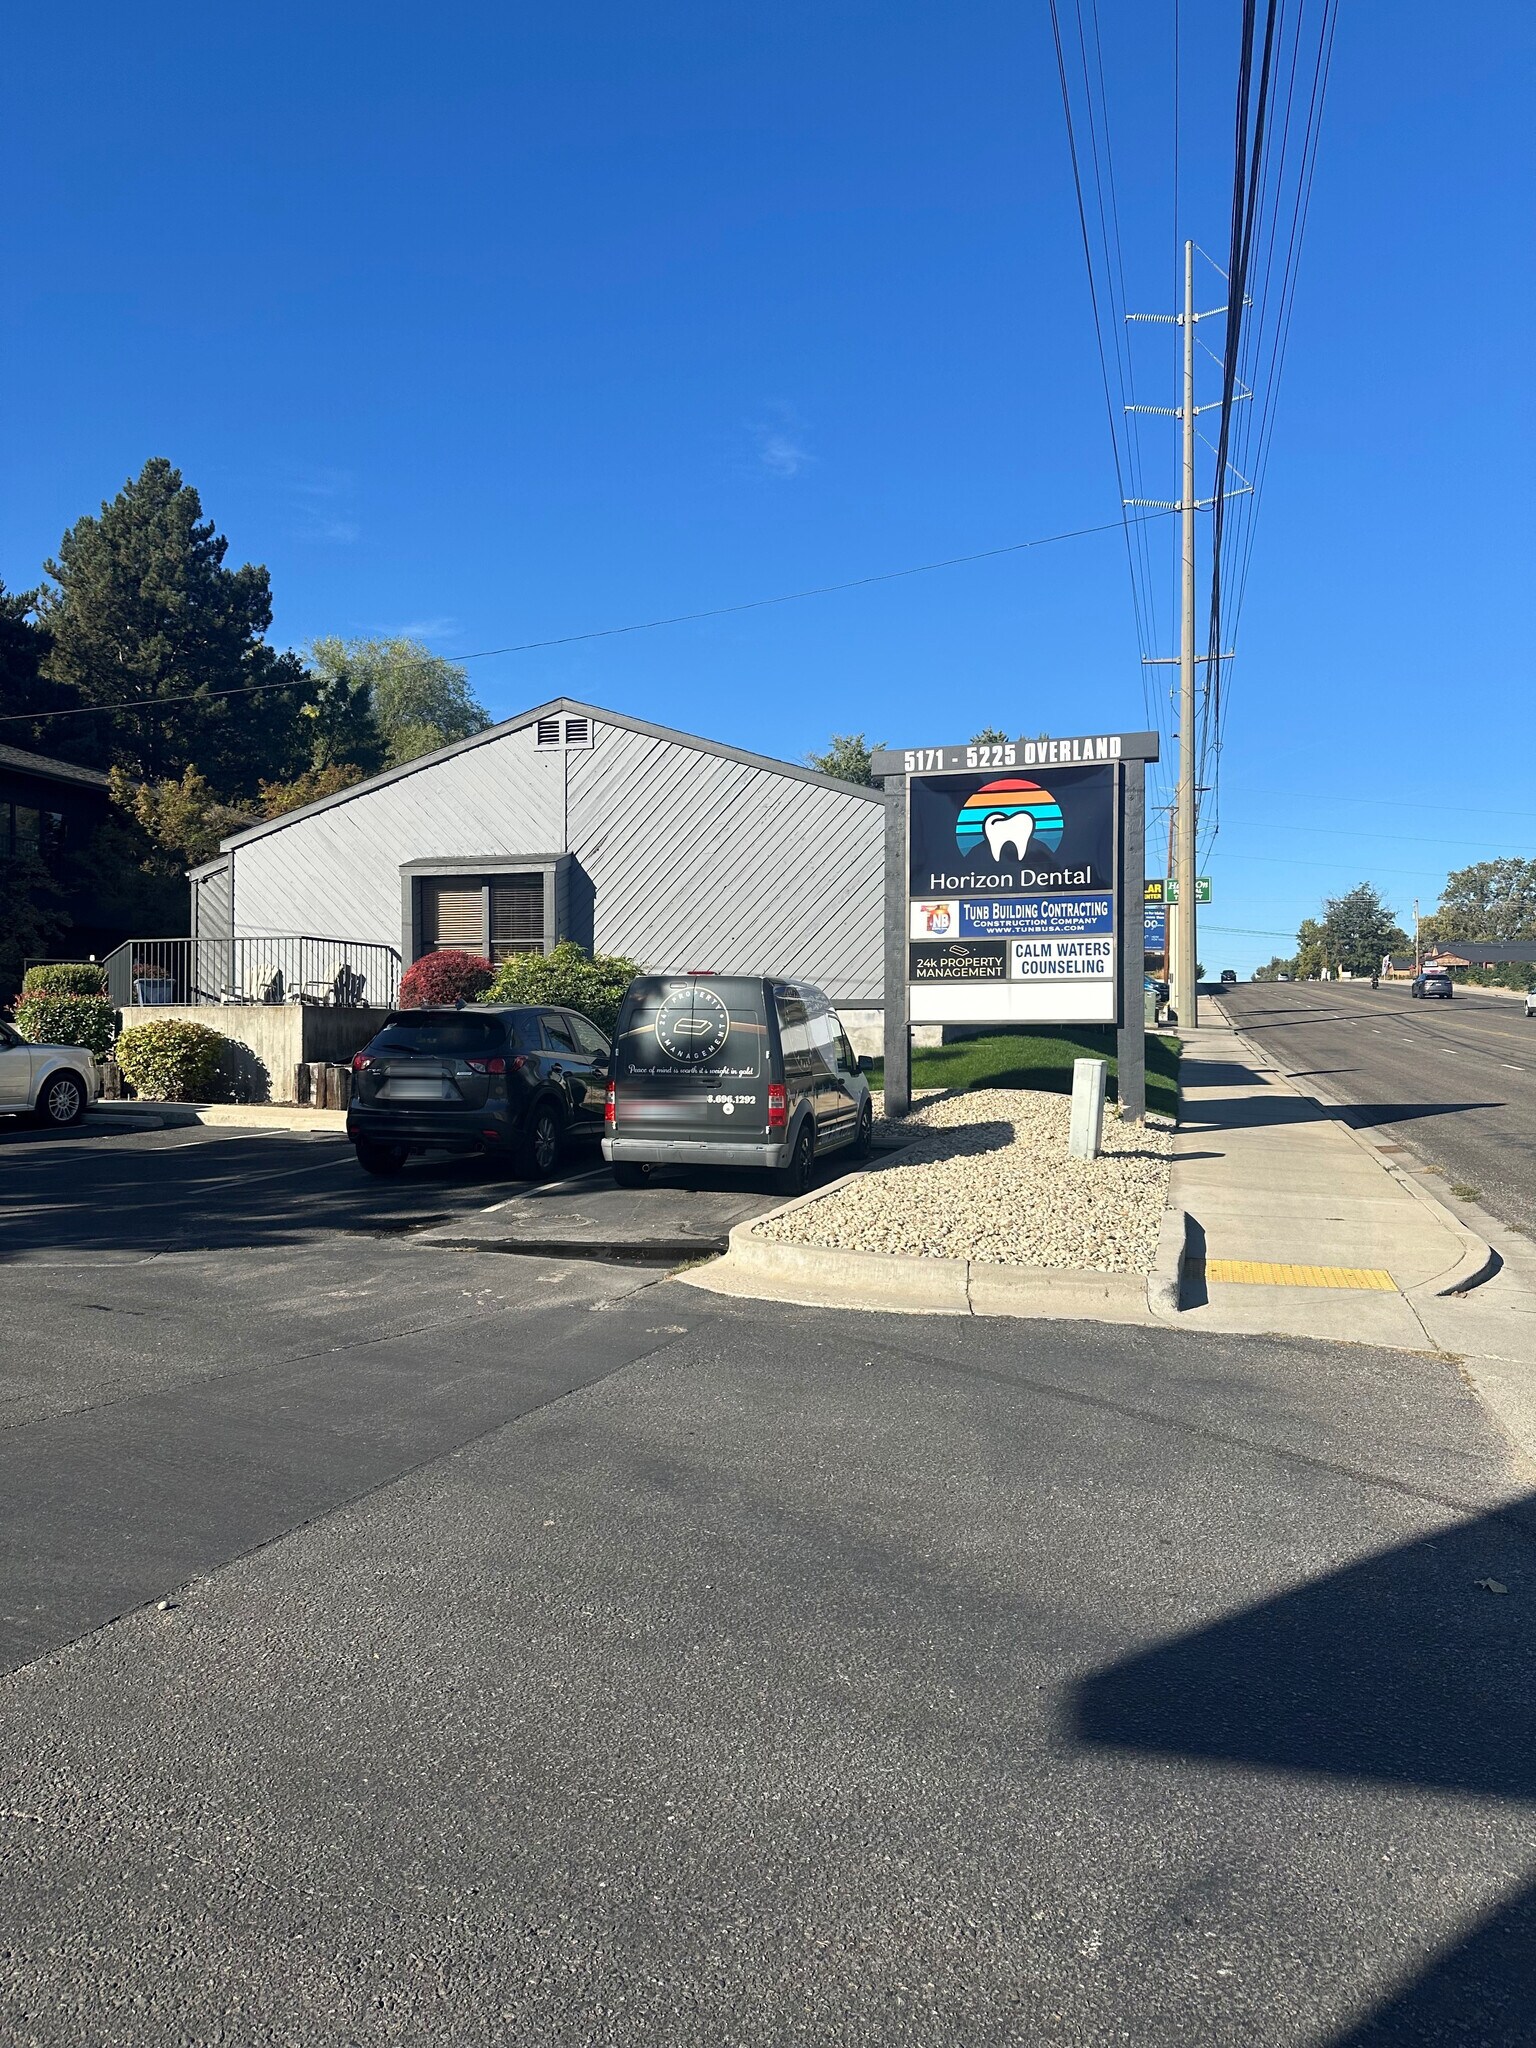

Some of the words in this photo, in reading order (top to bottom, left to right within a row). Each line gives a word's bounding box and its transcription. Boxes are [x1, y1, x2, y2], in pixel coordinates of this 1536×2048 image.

[904, 749, 944, 772] 5171
[966, 744, 1016, 768] 5225
[1024, 736, 1121, 764] OVERLAND
[930, 871, 1013, 890] Horizon
[1020, 865, 1091, 887] Dental
[1144, 884, 1162, 893] AR
[963, 903, 990, 920] TUNB
[992, 902, 1038, 920] BUILDING
[1041, 900, 1108, 918] CONTRACTING
[973, 918, 1047, 928] CONSTRUCTION
[1050, 917, 1098, 925] COMPANY
[1015, 943, 1052, 958] CALM
[1057, 942, 1111, 957] WATERS
[916, 958, 938, 968] 24k
[940, 956, 1003, 968] PROPERTY
[1021, 959, 1104, 975] COUNSELING
[916, 967, 1003, 978] MANAGEMENT
[671, 990, 721, 1010] PROPERTY
[664, 1023, 726, 1059] MANAGEMENT
[628, 1063, 646, 1074] Peace
[648, 1065, 656, 1076] of
[673, 1066, 679, 1074] is
[709, 1065, 730, 1078] weight
[730, 1067, 738, 1075] in
[738, 1066, 754, 1078] gold
